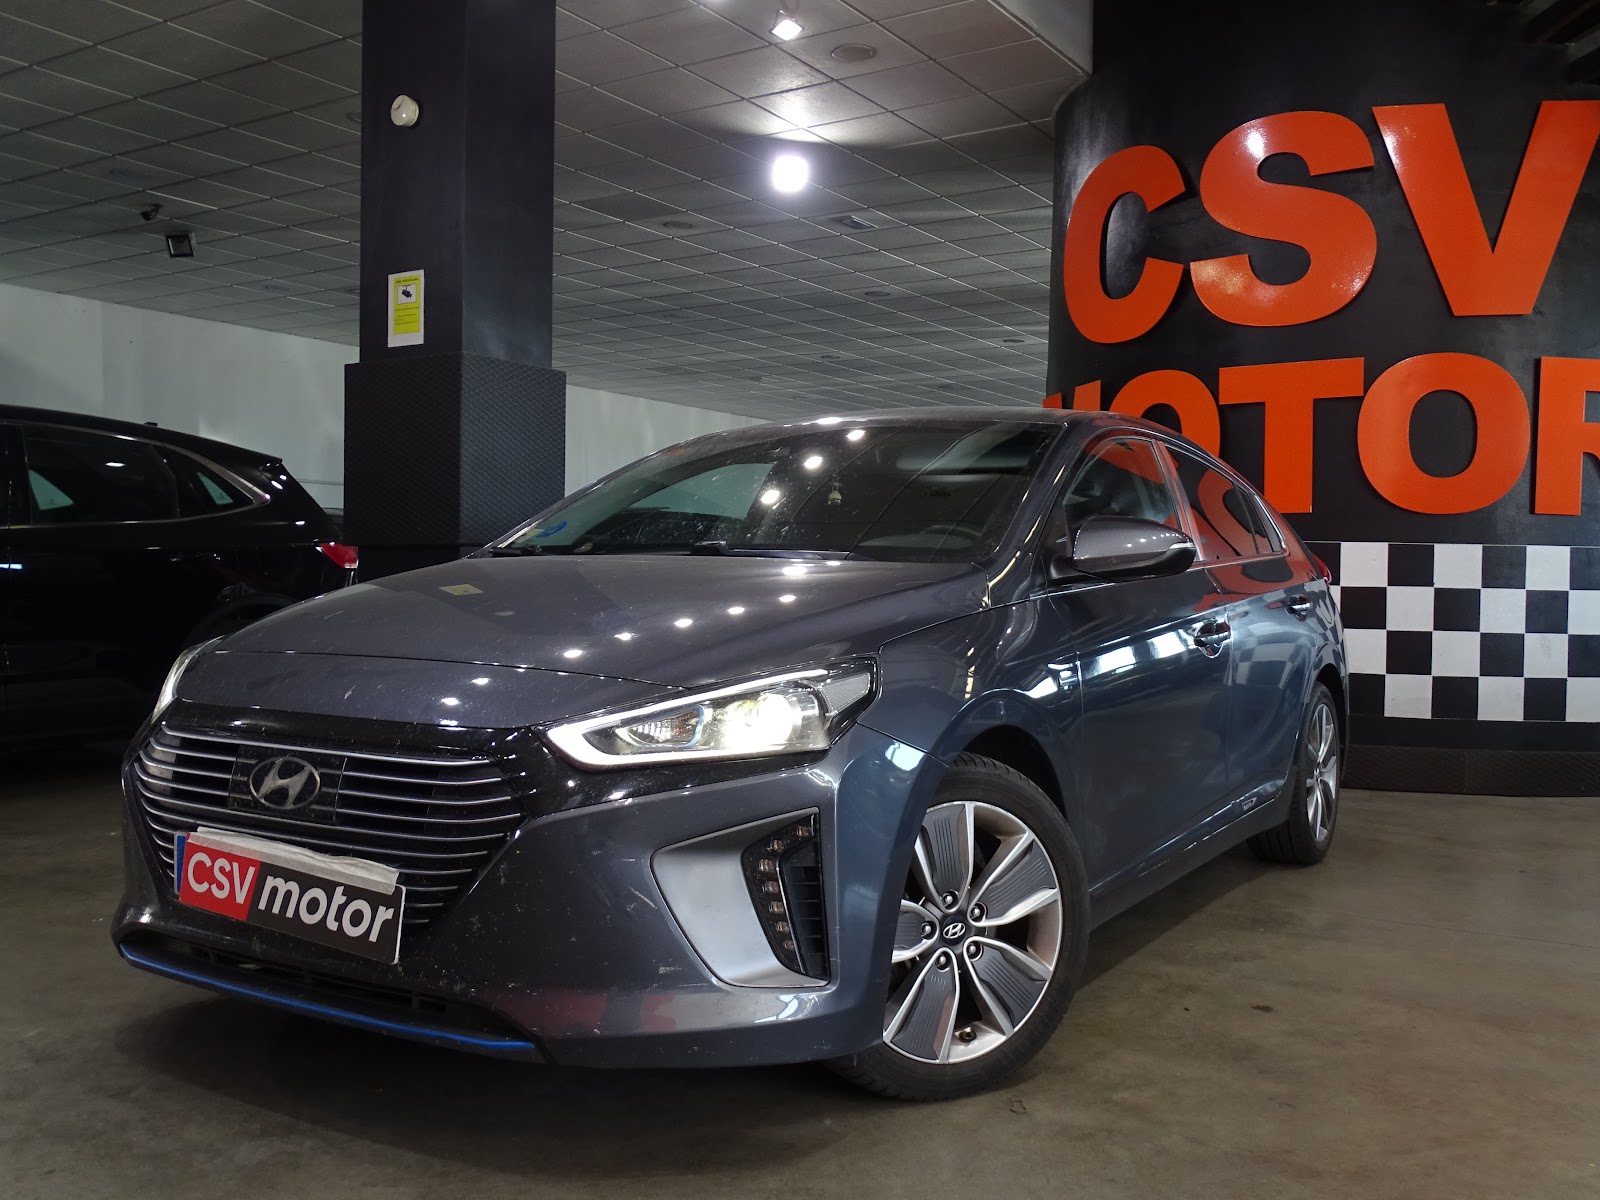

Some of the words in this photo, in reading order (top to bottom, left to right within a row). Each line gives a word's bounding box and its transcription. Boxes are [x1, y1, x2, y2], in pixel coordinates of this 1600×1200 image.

[1063, 100, 1600, 343] CSV
[1043, 352, 1600, 516] OTO
[187, 852, 255, 904] CSV
[258, 875, 394, 943] motor
